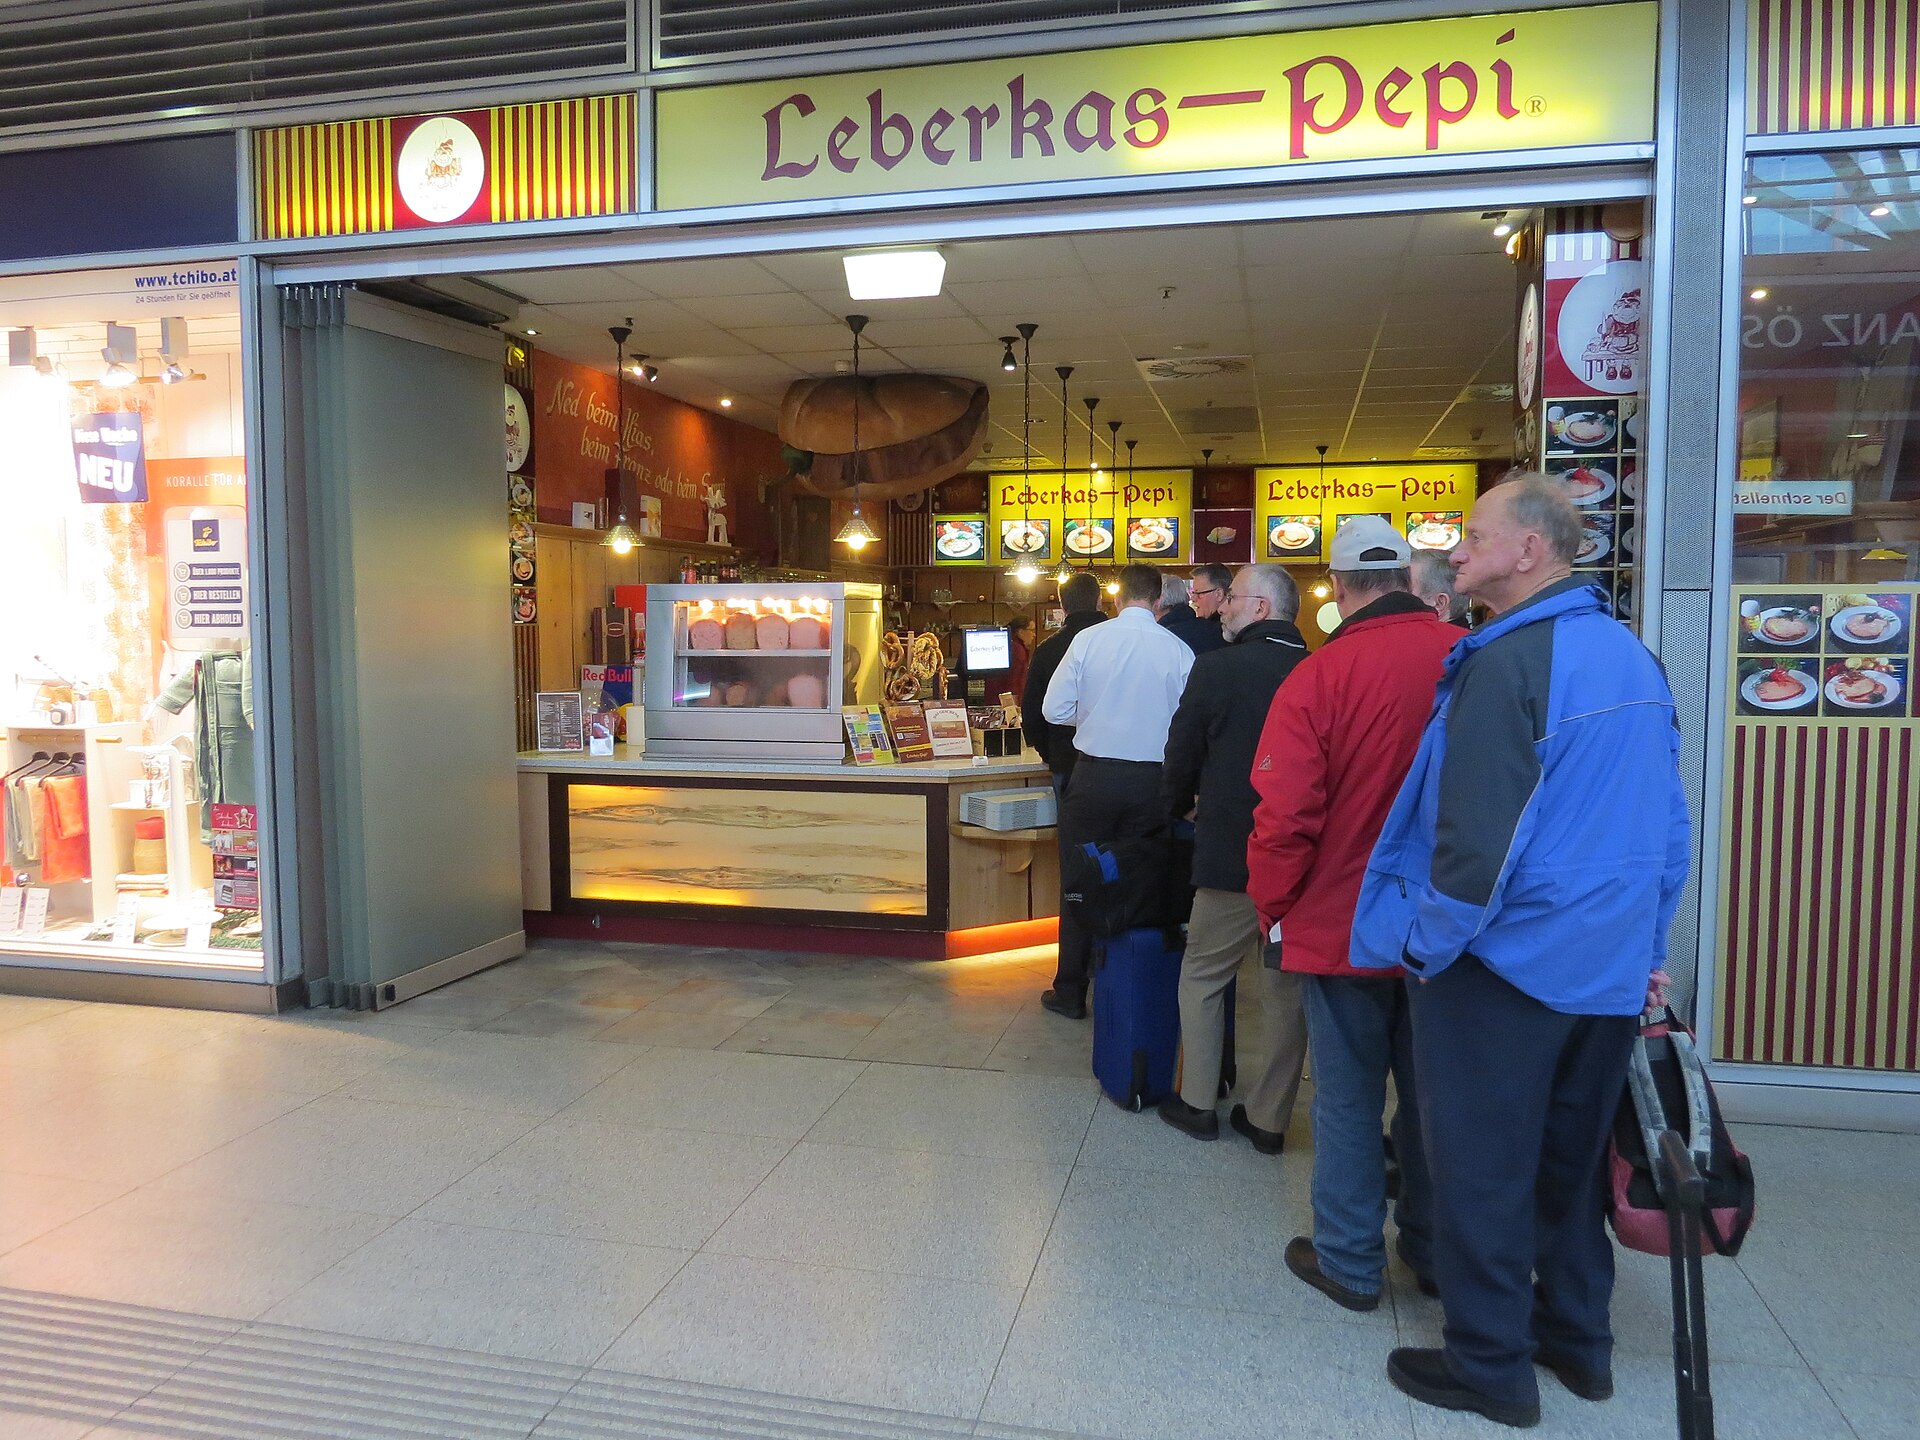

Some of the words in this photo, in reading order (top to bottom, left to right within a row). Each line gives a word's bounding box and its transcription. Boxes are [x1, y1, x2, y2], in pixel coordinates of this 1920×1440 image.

[135, 268, 237, 288] www.tchibo.at
[135, 296, 145, 304] 24
[146, 295, 175, 304] Stunden
[189, 292, 200, 300] Sie
[201, 291, 231, 299] geöffnet
[546, 378, 584, 418] Ned
[586, 391, 619, 432] beim
[580, 425, 610, 464] beim
[654, 467, 673, 494] oda
[677, 472, 697, 499] beim
[79, 452, 134, 493] NEU
[166, 476, 210, 487] KORALLE
[582, 667, 607, 682] Red
[607, 668, 632, 683] Bull
